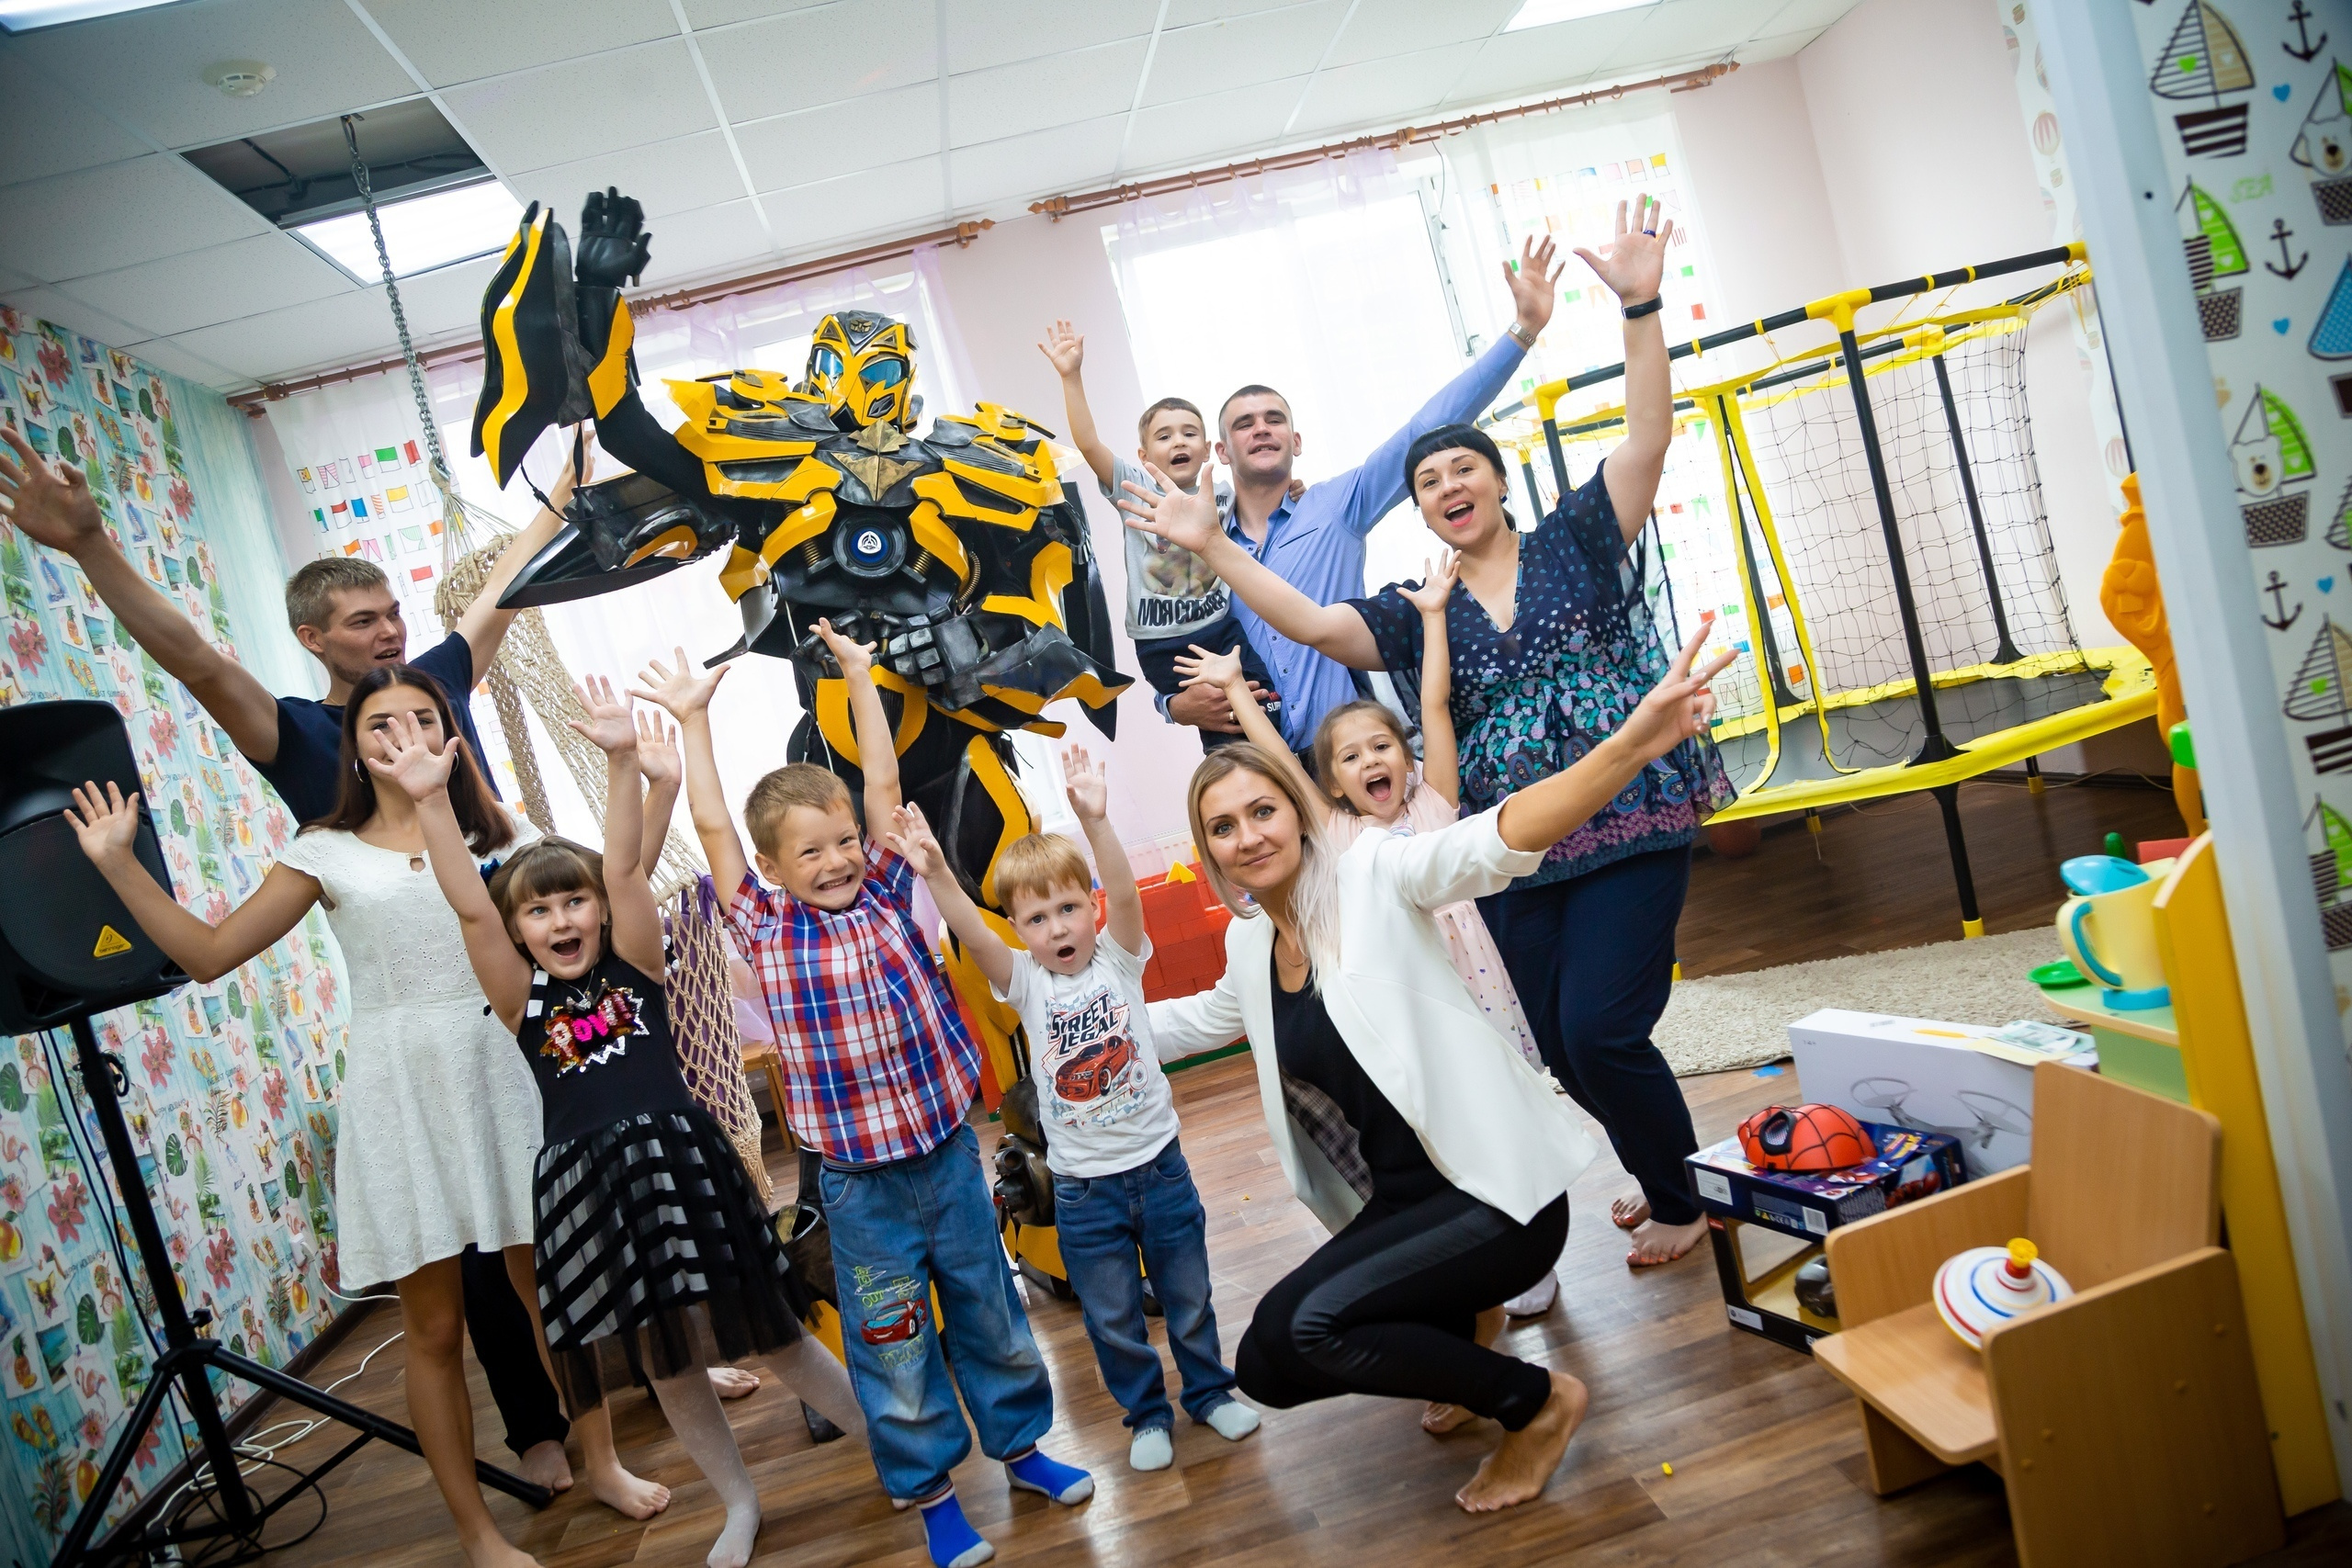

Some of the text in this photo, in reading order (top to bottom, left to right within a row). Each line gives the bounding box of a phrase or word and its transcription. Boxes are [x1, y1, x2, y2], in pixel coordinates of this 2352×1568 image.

[1137, 598, 1174, 626] МОЯ
[1049, 993, 1109, 1040] STREET
[1058, 1011, 1118, 1055] LEGAL
[862, 1289, 884, 1309] OUT
